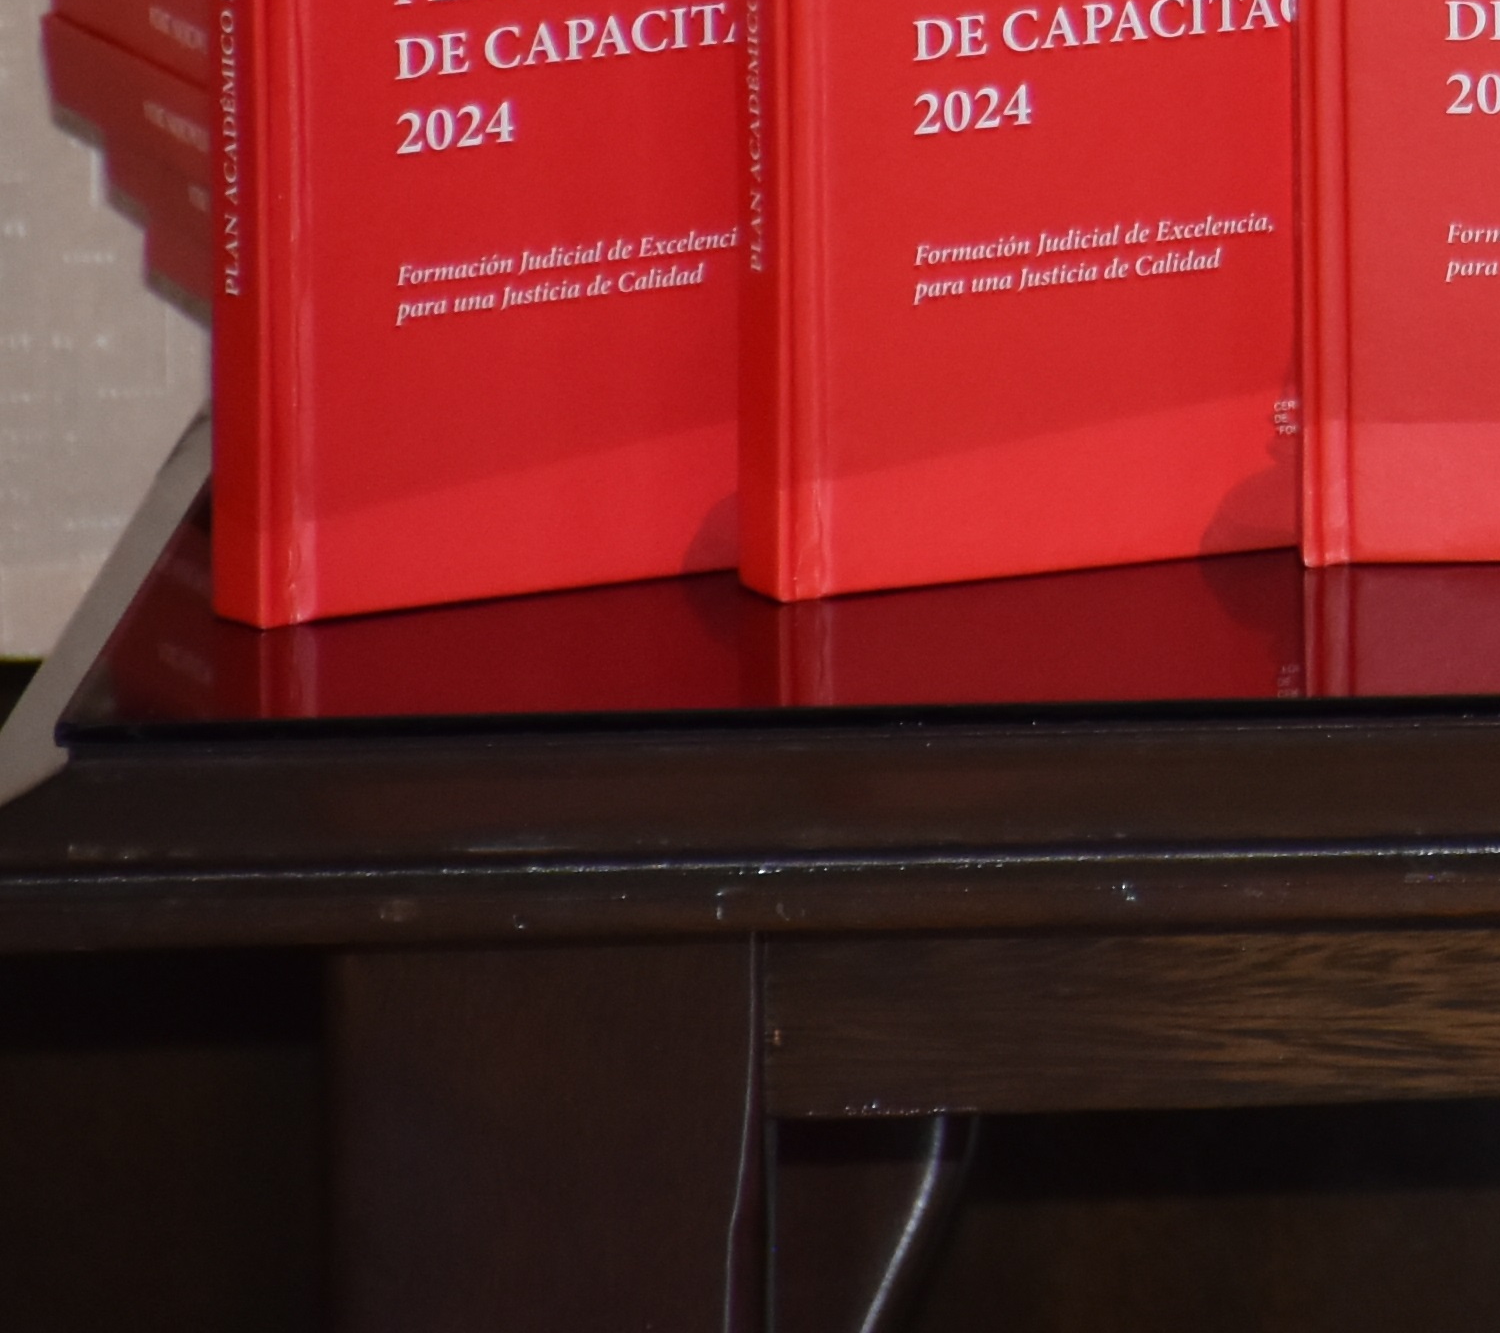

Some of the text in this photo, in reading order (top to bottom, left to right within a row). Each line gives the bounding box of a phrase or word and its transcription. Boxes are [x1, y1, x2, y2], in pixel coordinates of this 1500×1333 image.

[395, 3, 736, 80] DE CAPACIT
[912, 14, 988, 62] DE
[219, 10, 238, 205] ACADÉMICO
[396, 102, 514, 155] 2024
[913, 84, 1032, 135] 2024
[224, 213, 240, 295] PLAN
[397, 254, 513, 286] Formación
[518, 241, 603, 276] Judicial
[608, 239, 633, 262] de
[914, 213, 1273, 267] Formación Judicial de Excelencia,
[395, 263, 704, 326] para una Justicia de Calidad
[913, 247, 1222, 306] para una Justicia de Calidad
[1445, 256, 1498, 282] para
